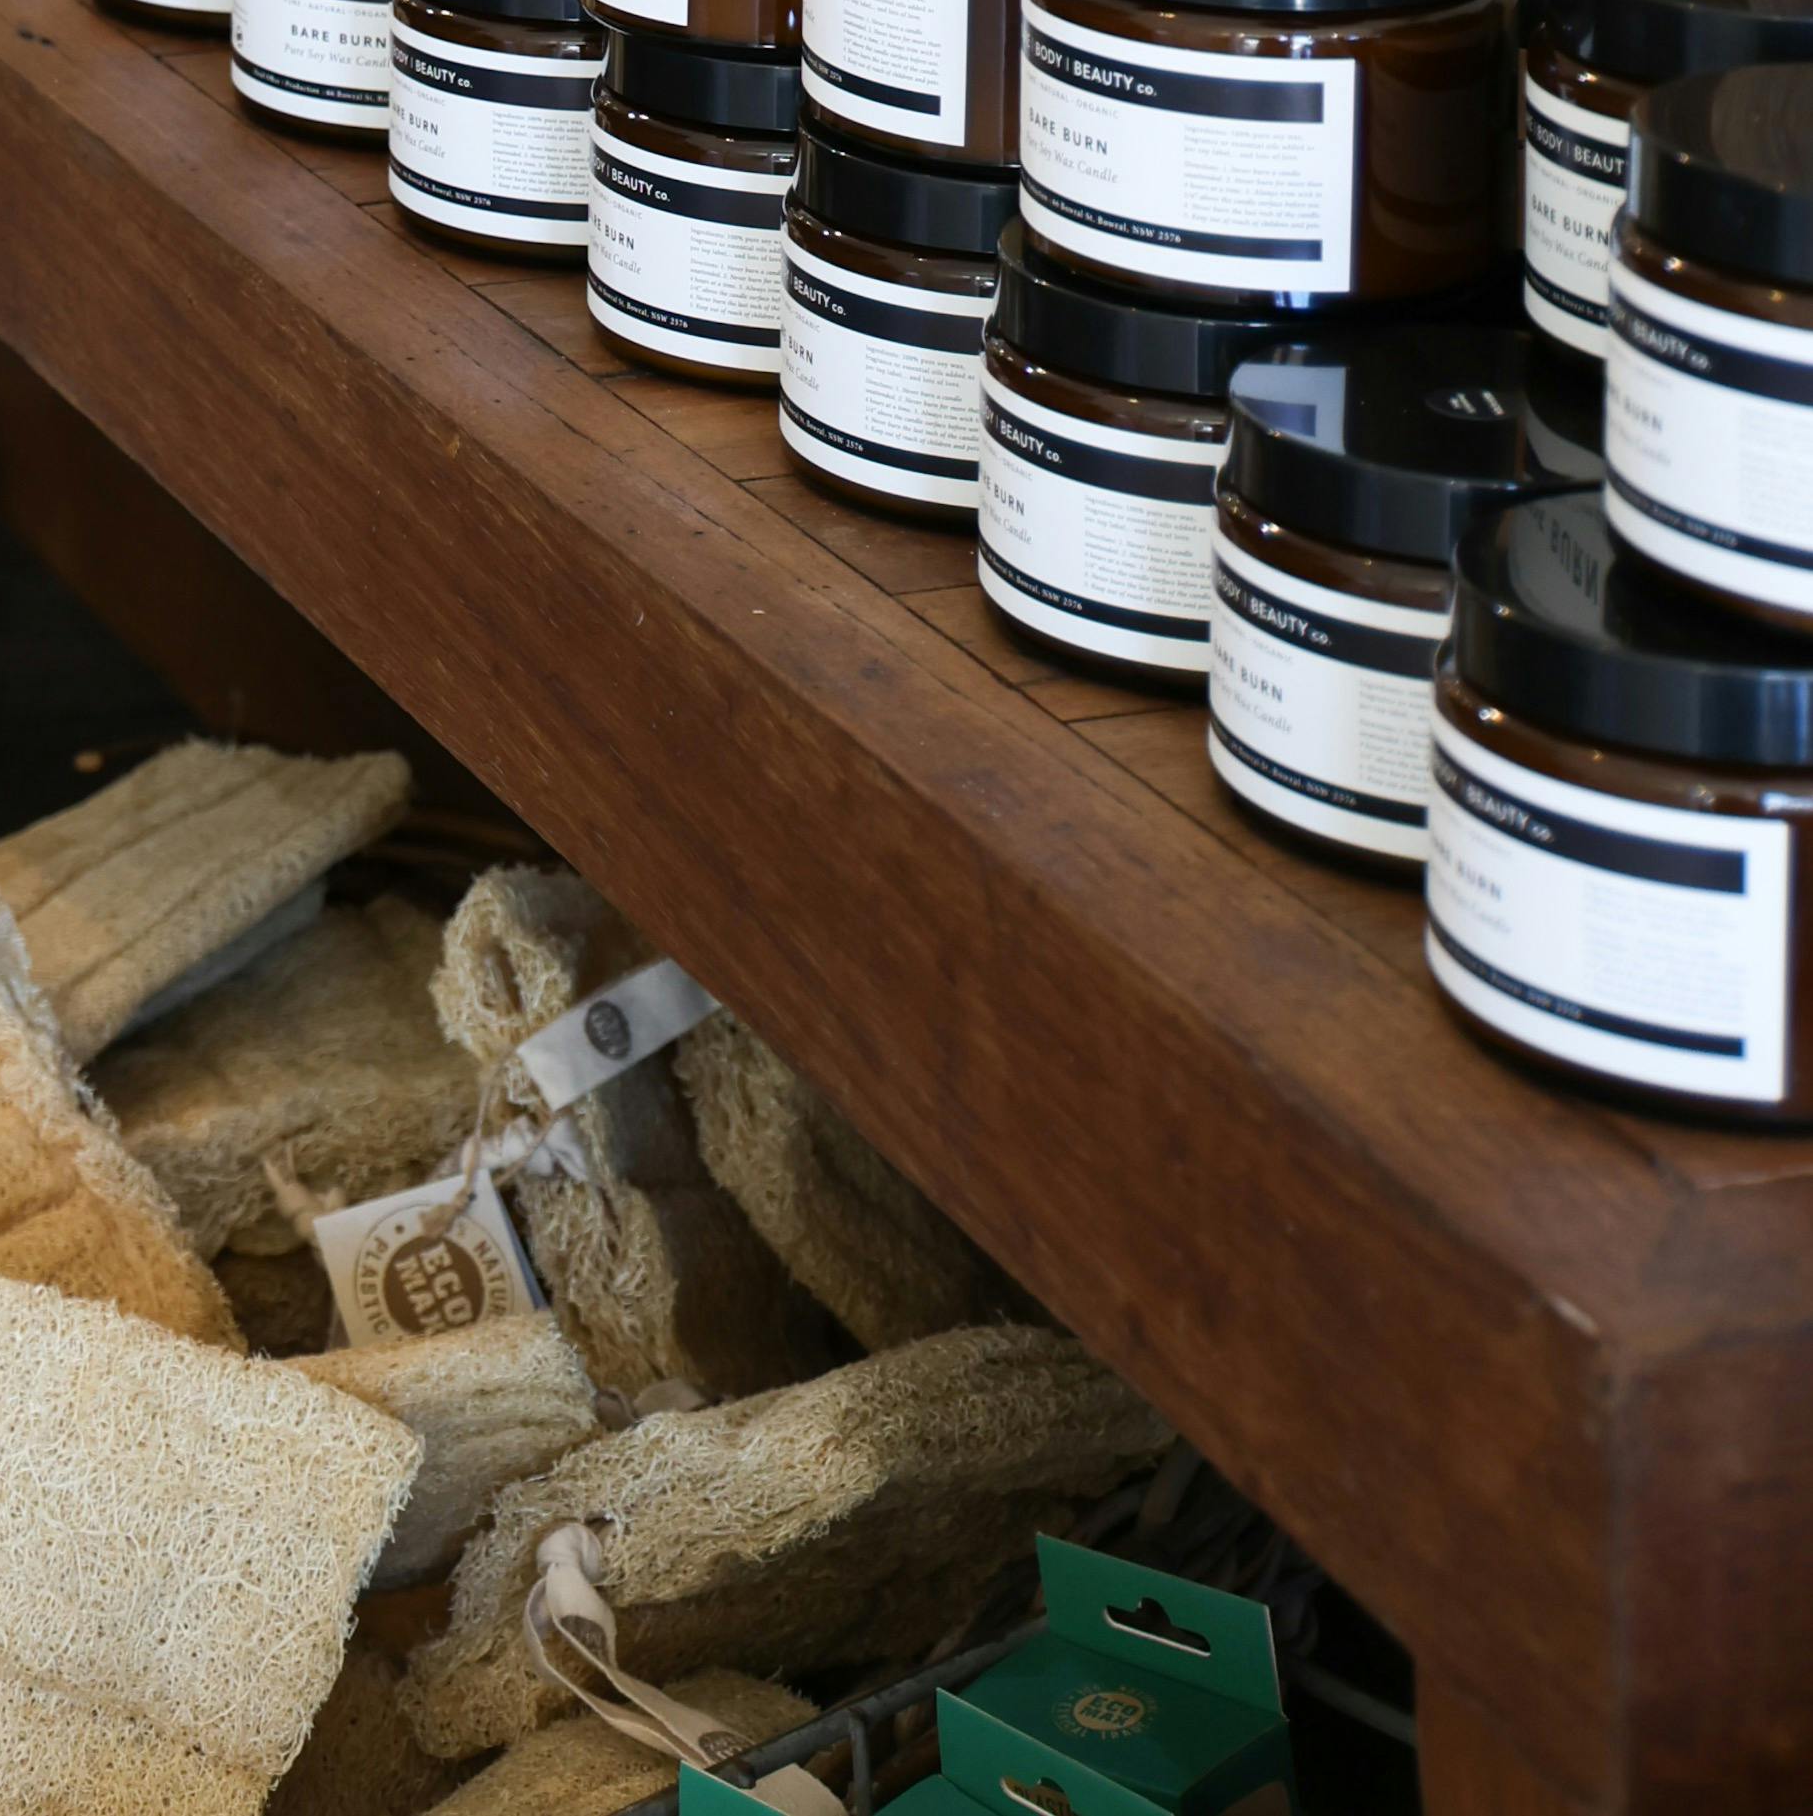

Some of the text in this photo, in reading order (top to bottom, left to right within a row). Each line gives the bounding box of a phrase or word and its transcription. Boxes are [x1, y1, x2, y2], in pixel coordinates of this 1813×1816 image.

[354, 7, 388, 19] ORGAN
[290, 23, 387, 50] BARE BURN
[283, 42, 391, 69] Pure Soy Wax Candl
[1034, 41, 1158, 97] BODY BEAUTY co.
[414, 57, 457, 85] BEAUTY
[457, 77, 474, 89] co.
[408, 111, 439, 136] BURN
[1075, 97, 1120, 120] ORGANIC
[1028, 107, 1109, 156] BARE BURN
[417, 139, 446, 159] Candle
[1536, 125, 1627, 176] BODY BEAUT
[610, 167, 671, 203] BEAUTY co.
[1053, 151, 1075, 169] Wax
[1076, 159, 1120, 185] Candle
[603, 223, 635, 251] BURN
[1131, 224, 1156, 240] NSW
[1531, 193, 1610, 247] BARE BURN
[612, 253, 643, 276] Candle
[1577, 251, 1610, 274] Cand
[792, 275, 847, 317] BEAUTY co.
[650, 310, 668, 325] NSW
[788, 335, 815, 365] BURN
[1633, 321, 1690, 360] BEAUTY
[795, 365, 821, 393] Candle
[999, 417, 1063, 465] BEAUTY co.
[993, 483, 1026, 517] BURN
[1002, 516, 1033, 546] Candle
[1249, 596, 1310, 639] BEAUTY
[1309, 627, 1333, 647] co.
[1240, 665, 1284, 703] BURN
[1465, 782, 1531, 832] BEAUTY
[360, 1235, 391, 1337] PLASTIC
[419, 1240, 475, 1327] ECO
[473, 1238, 508, 1317] NATUR
